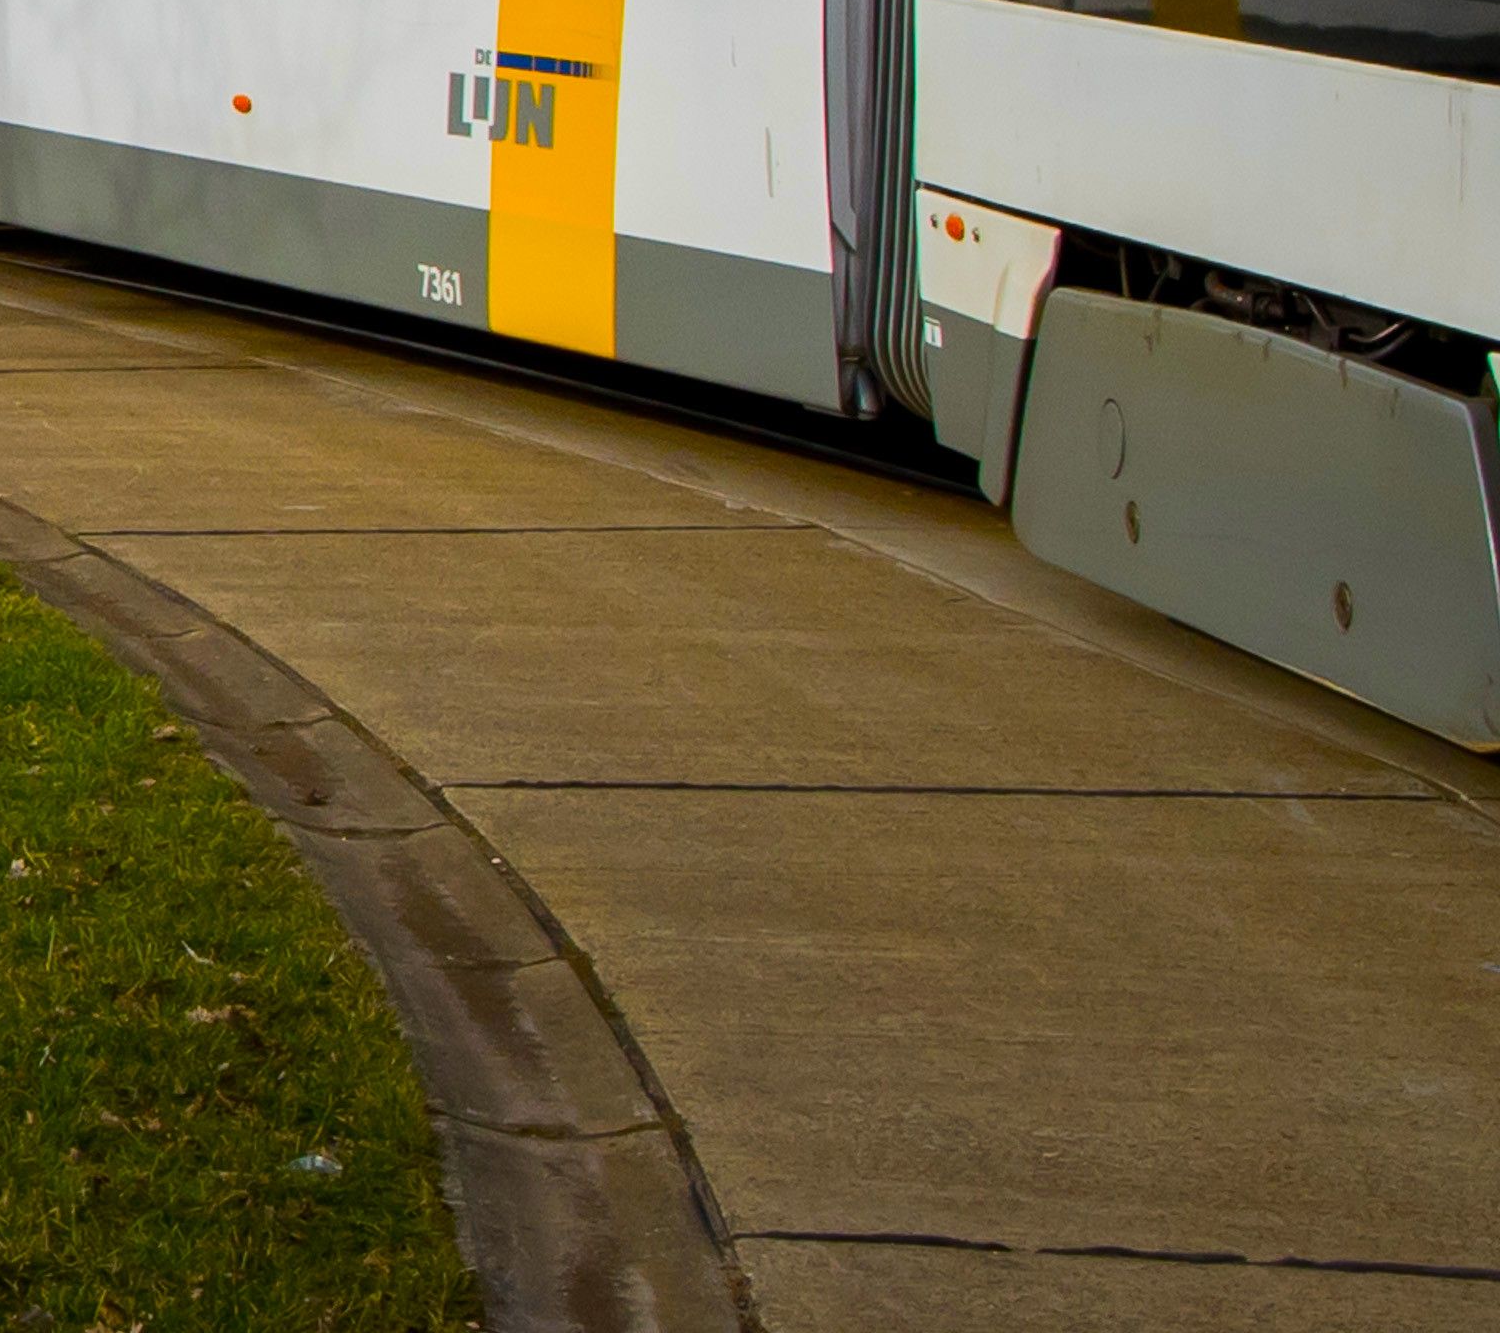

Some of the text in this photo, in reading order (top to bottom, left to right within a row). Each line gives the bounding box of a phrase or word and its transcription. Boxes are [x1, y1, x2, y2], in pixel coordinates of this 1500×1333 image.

[475, 48, 492, 65] DE
[447, 72, 555, 149] LIJN
[417, 263, 462, 306] 7361
